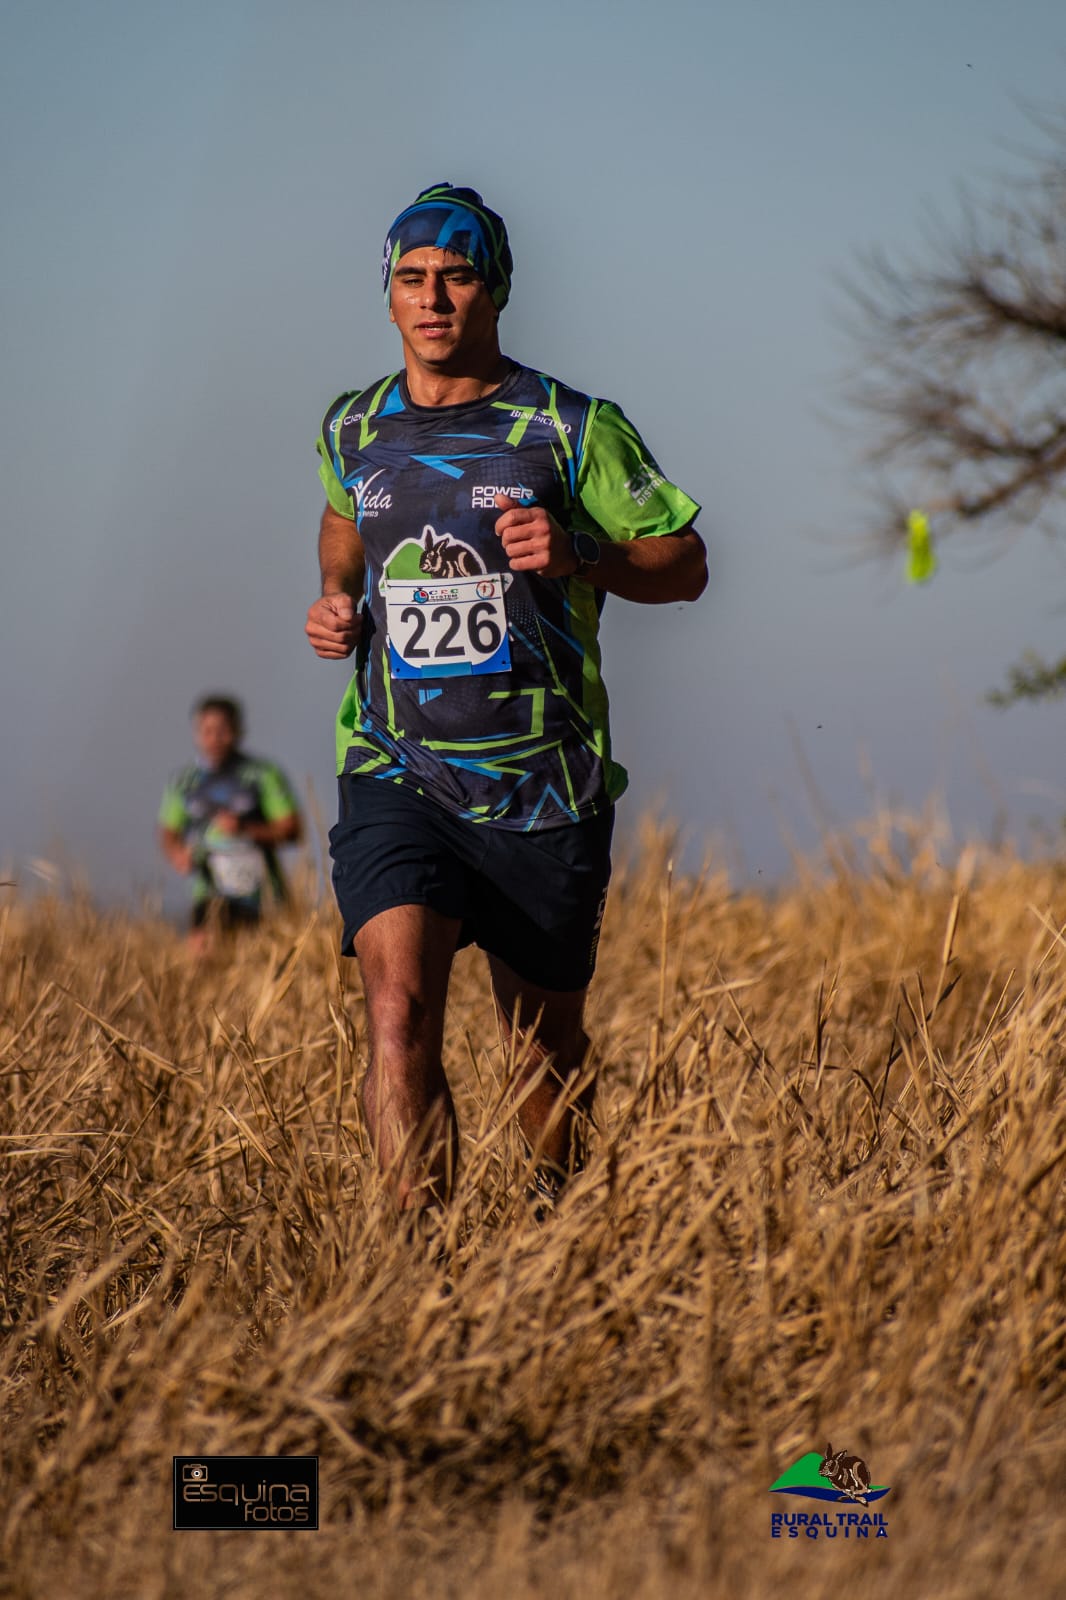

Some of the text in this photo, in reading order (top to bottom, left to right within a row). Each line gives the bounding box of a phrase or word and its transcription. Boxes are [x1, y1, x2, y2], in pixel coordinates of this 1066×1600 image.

[352, 468, 393, 509] Vida
[471, 496, 499, 509] AD
[472, 485, 534, 500] POWER
[400, 602, 502, 658] 226
